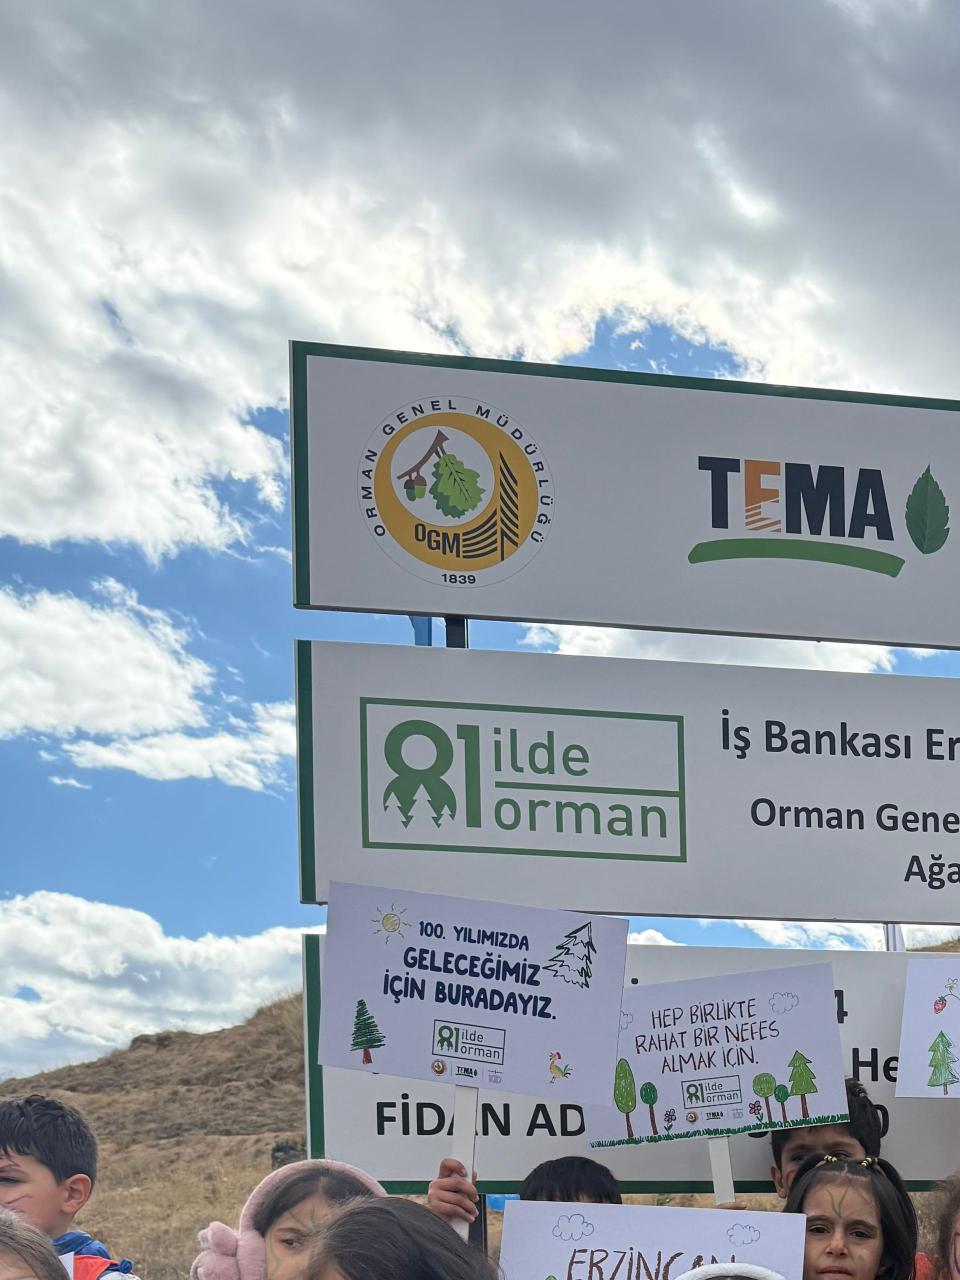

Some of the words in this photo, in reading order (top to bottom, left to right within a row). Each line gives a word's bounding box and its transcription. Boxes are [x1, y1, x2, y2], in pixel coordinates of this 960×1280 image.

[361, 449, 386, 537] ORMAN
[382, 399, 456, 436] GENEL
[475, 405, 553, 544] MÜDÜRLÜĞÜ
[698, 455, 895, 541] TEMA
[414, 523, 461, 558] OGM
[441, 573, 476, 584] 1839
[721, 708, 751, 760] İş
[764, 719, 911, 761] Bankası
[382, 719, 483, 829] 81
[493, 726, 590, 776] ilde
[493, 797, 668, 838] orman
[750, 798, 865, 831] Orman
[419, 920, 446, 941] 100.
[453, 925, 530, 951] YILIMIZDA
[403, 946, 541, 986] GELECEĞİMİZ
[383, 968, 426, 1003] İÇİN
[434, 981, 556, 1020] BURADAYIZ.
[651, 1007, 684, 1029] HEP
[690, 998, 757, 1026] BİRLİKTE
[437, 1024, 460, 1053] 81
[461, 1028, 484, 1043] ilde
[460, 1044, 501, 1060] orman
[635, 1031, 687, 1054] RAHAT
[693, 1023, 719, 1048] BİR
[724, 1020, 780, 1044] NEFES
[456, 1065, 474, 1076] TEMA
[661, 1050, 717, 1074] ALMAK
[722, 1045, 759, 1068] İÇİN.
[686, 1083, 704, 1104] 81
[704, 1080, 723, 1092] ilde
[706, 1091, 739, 1103] orman
